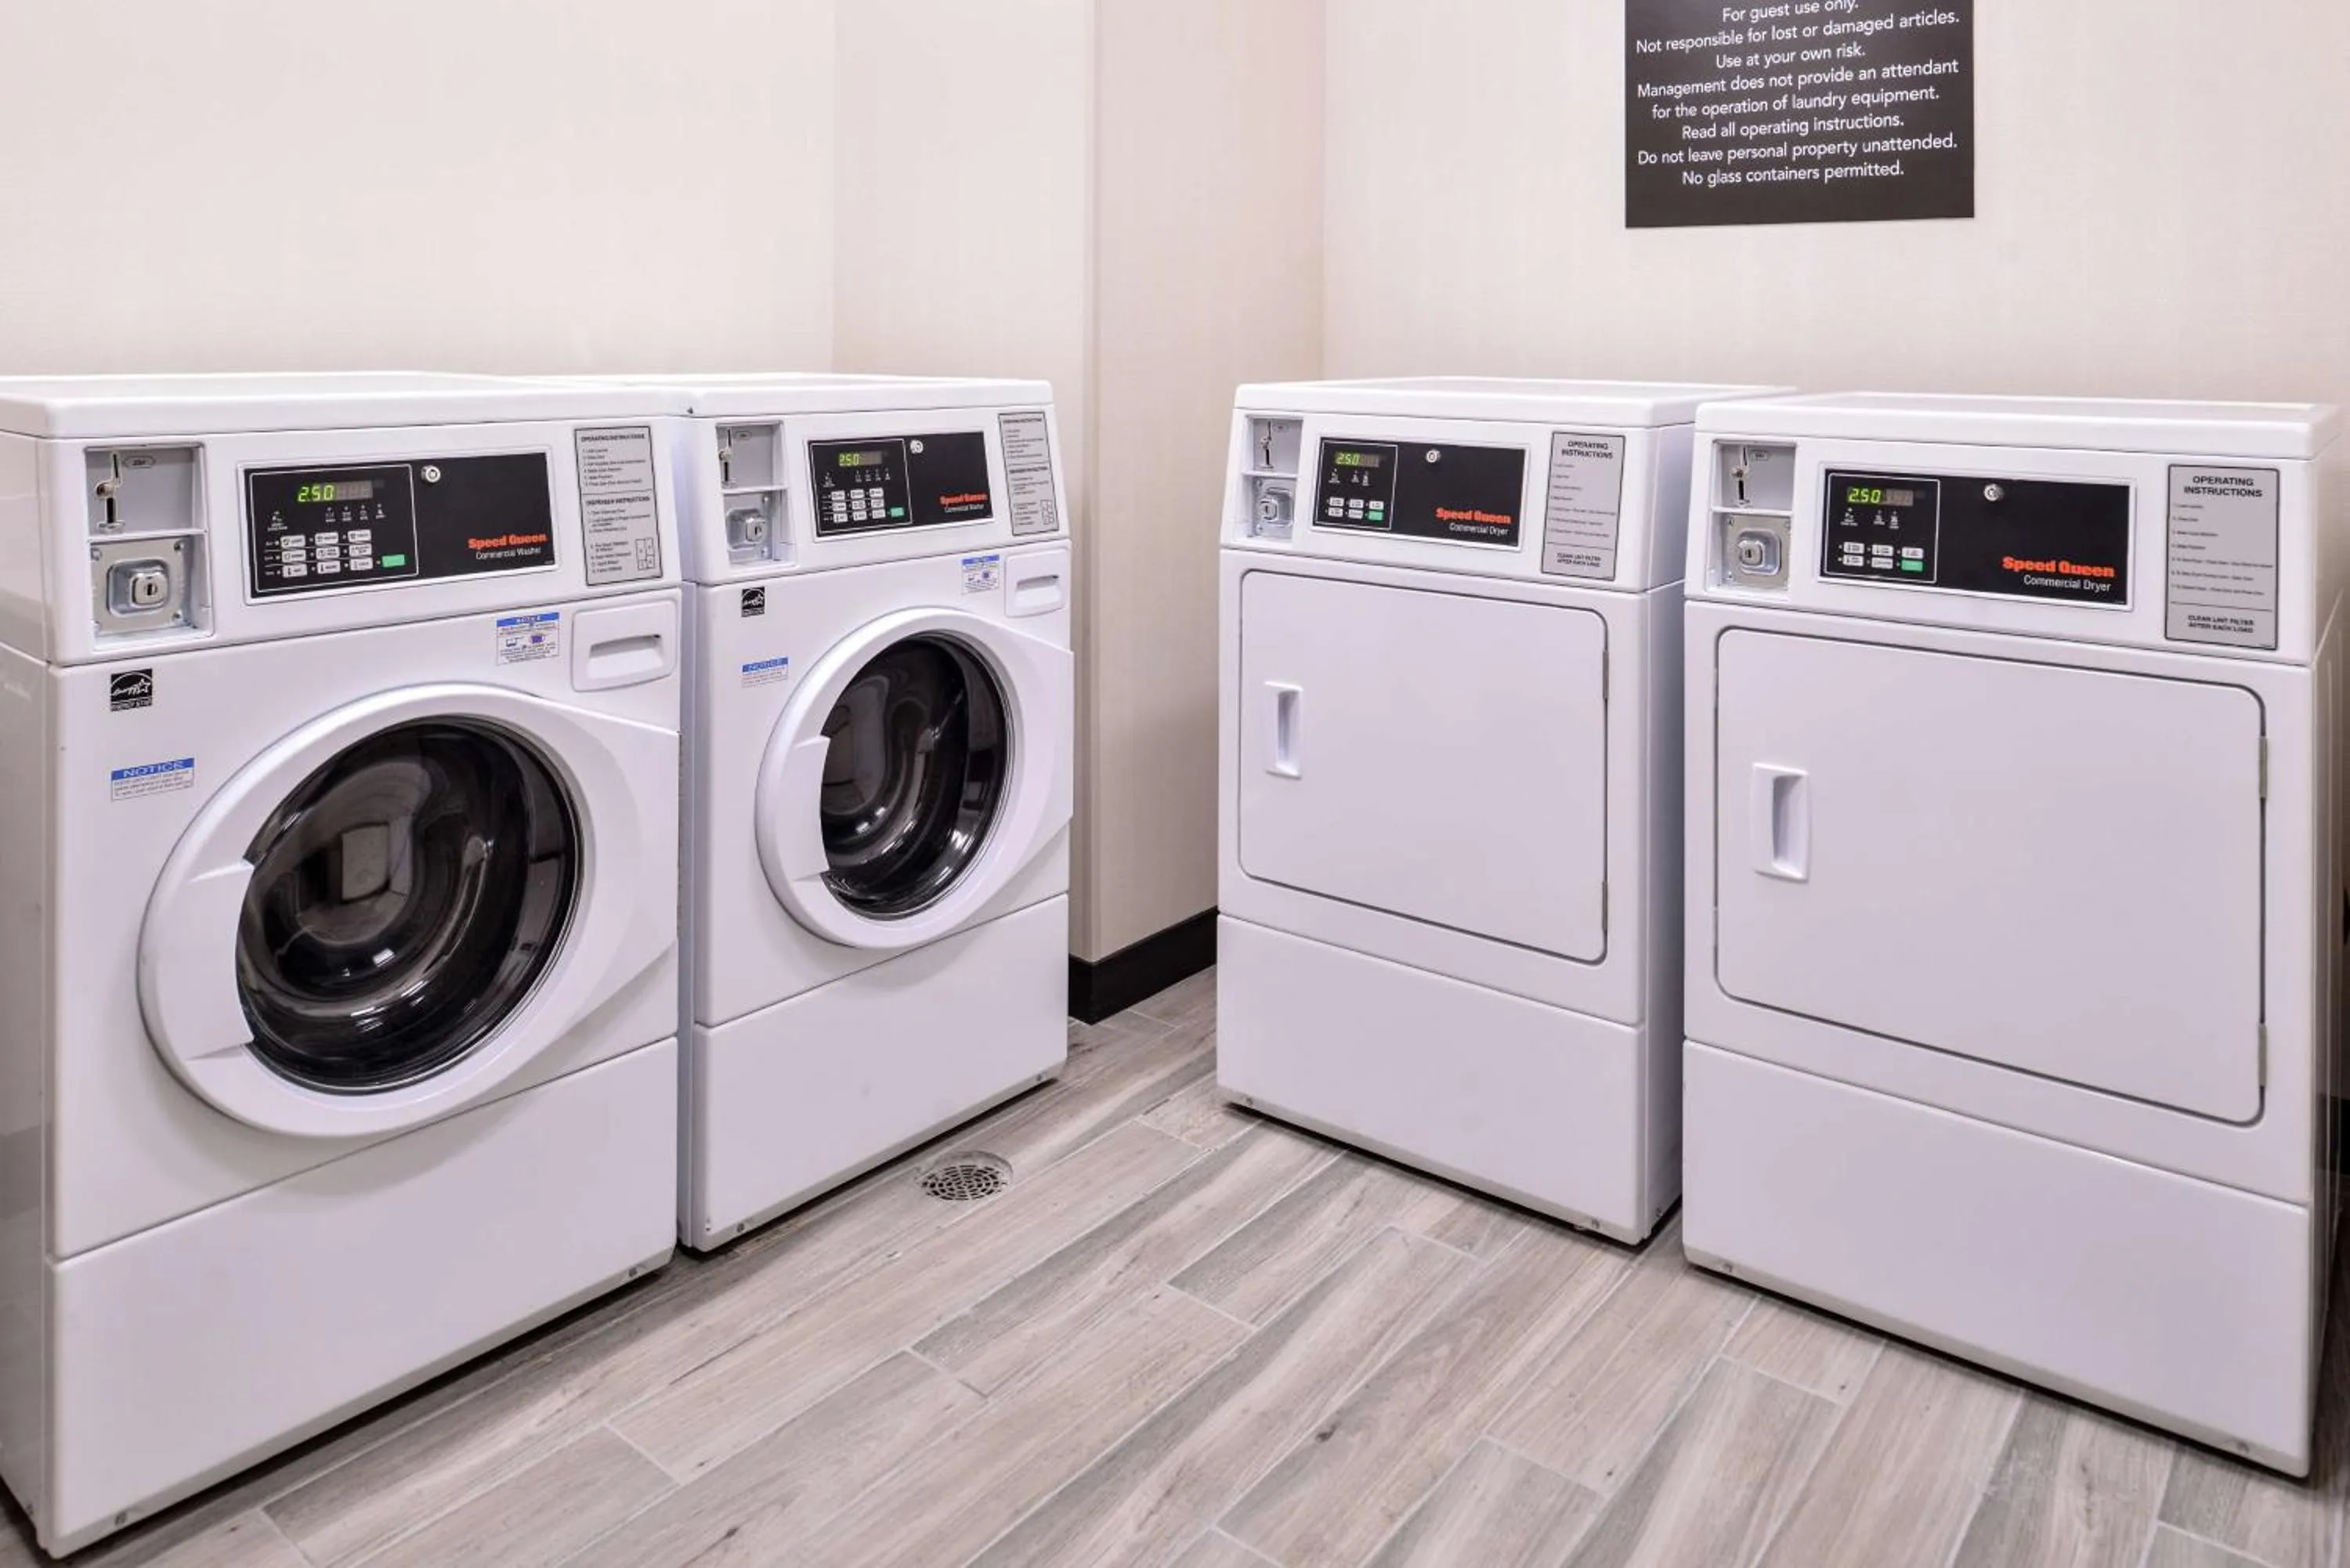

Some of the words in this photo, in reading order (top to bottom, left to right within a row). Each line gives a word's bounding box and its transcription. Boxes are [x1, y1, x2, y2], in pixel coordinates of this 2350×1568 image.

[1723, 8, 1745, 22] For
[1749, 3, 1790, 23] guest
[1795, 2, 1820, 14] use
[1824, 0, 1859, 13] only.
[1636, 40, 1661, 53] Not
[1666, 29, 1743, 53] responsible
[1748, 27, 1767, 42] for
[1771, 25, 1797, 40] lost
[1802, 26, 1817, 37] or
[1823, 13, 1893, 35] damaged
[1900, 9, 1959, 28] articles.
[1716, 54, 1742, 68] Use
[1746, 53, 1759, 67] at
[1763, 51, 1796, 68] your
[1801, 48, 1831, 60] own
[1836, 41, 1866, 59] risk.
[1637, 79, 1726, 99] Management
[1730, 75, 1764, 90] does
[1770, 74, 1792, 87] not
[1798, 67, 1853, 90] provide
[1859, 67, 1876, 81] an
[1882, 58, 1959, 78] attendant
[1652, 104, 1671, 119] for
[1675, 103, 1697, 117] the
[1701, 99, 1768, 119] operation
[1773, 94, 1788, 110] of
[1792, 92, 1847, 110] laundry
[1851, 86, 1940, 107] equipment.
[1682, 122, 1716, 139] Read
[1720, 121, 1735, 137] all
[1740, 119, 1809, 139] operating
[1813, 113, 1904, 131] instructions.
[1638, 150, 1658, 164] Do
[1661, 150, 1684, 164] not
[1688, 147, 1723, 161] leave
[1727, 142, 1787, 164] personal
[1792, 140, 1856, 161] property
[1862, 132, 1958, 153] unattended.
[1683, 171, 1704, 185] No
[1708, 168, 1741, 188] glass
[1746, 166, 1820, 182] containers
[1824, 159, 1904, 184] permitted.
[2183, 486, 2263, 497] INSTRUCTIONS
[2193, 475, 2254, 486] OPERATING
[1435, 508, 1472, 521] Speed
[1473, 513, 1511, 524] Queen
[1449, 522, 1488, 534] Commercial
[1489, 526, 1509, 537] Dryer
[468, 534, 507, 550] Speed
[508, 533, 547, 545] Queen
[2002, 556, 2056, 573] Speed
[2059, 561, 2115, 577] Queen
[2023, 574, 2081, 589] Commercial
[2083, 580, 2112, 592] Dryer
[123, 761, 185, 778] NOTICE
